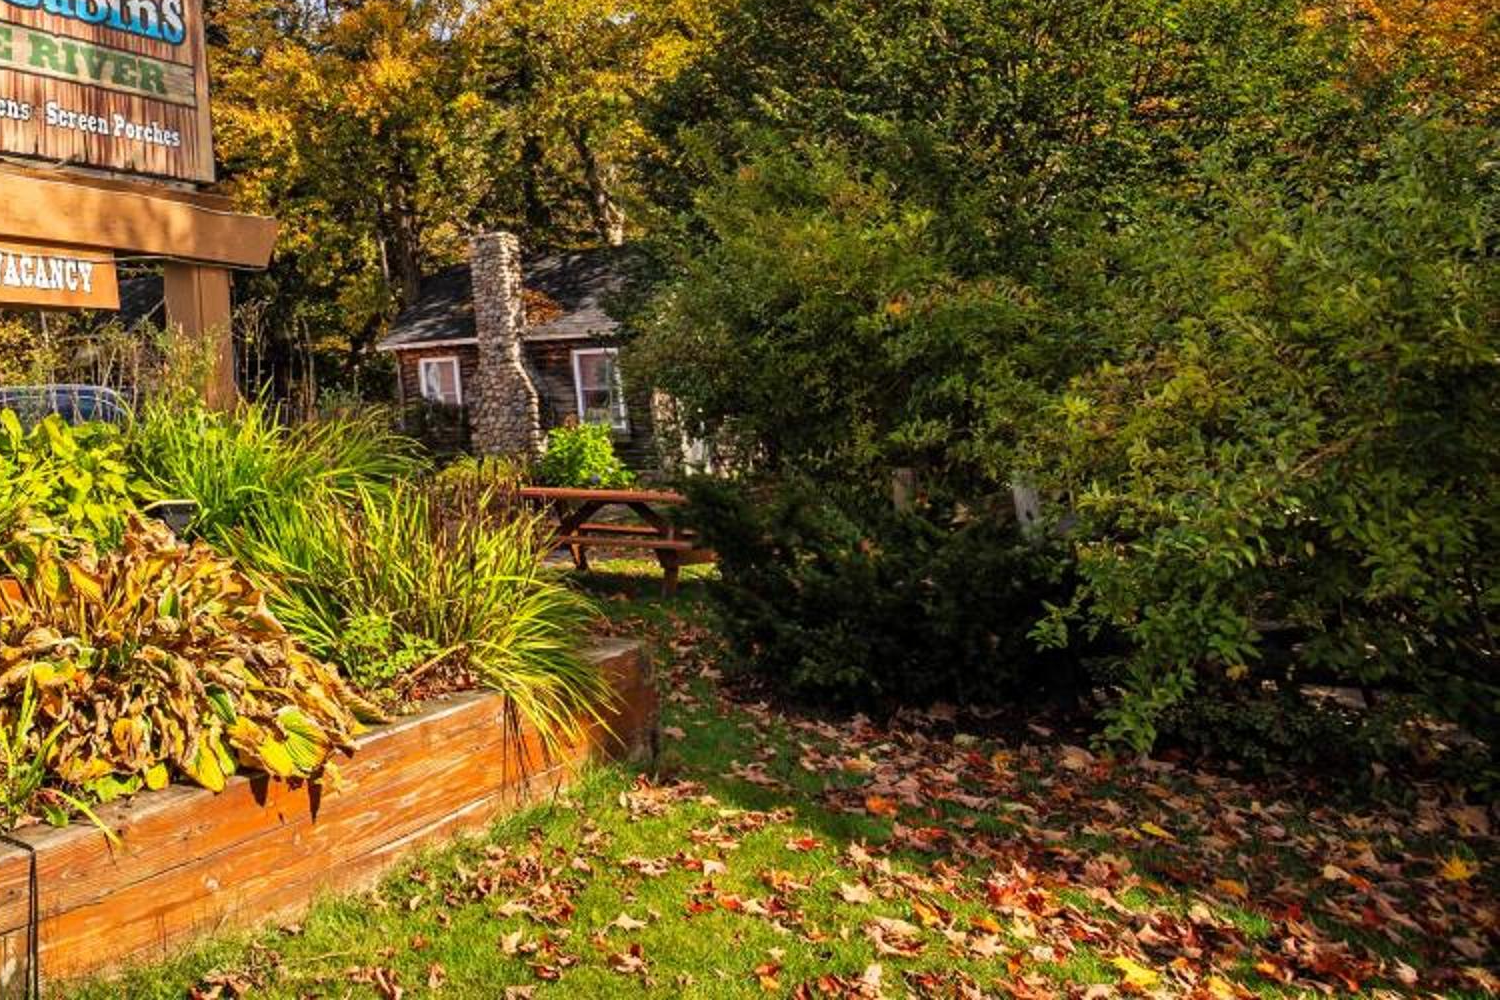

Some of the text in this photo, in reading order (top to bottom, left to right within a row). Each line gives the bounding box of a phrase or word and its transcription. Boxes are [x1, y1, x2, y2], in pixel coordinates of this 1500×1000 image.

[27, 32, 167, 96] RIVER
[45, 102, 109, 135] Screen
[112, 113, 181, 147] Porches
